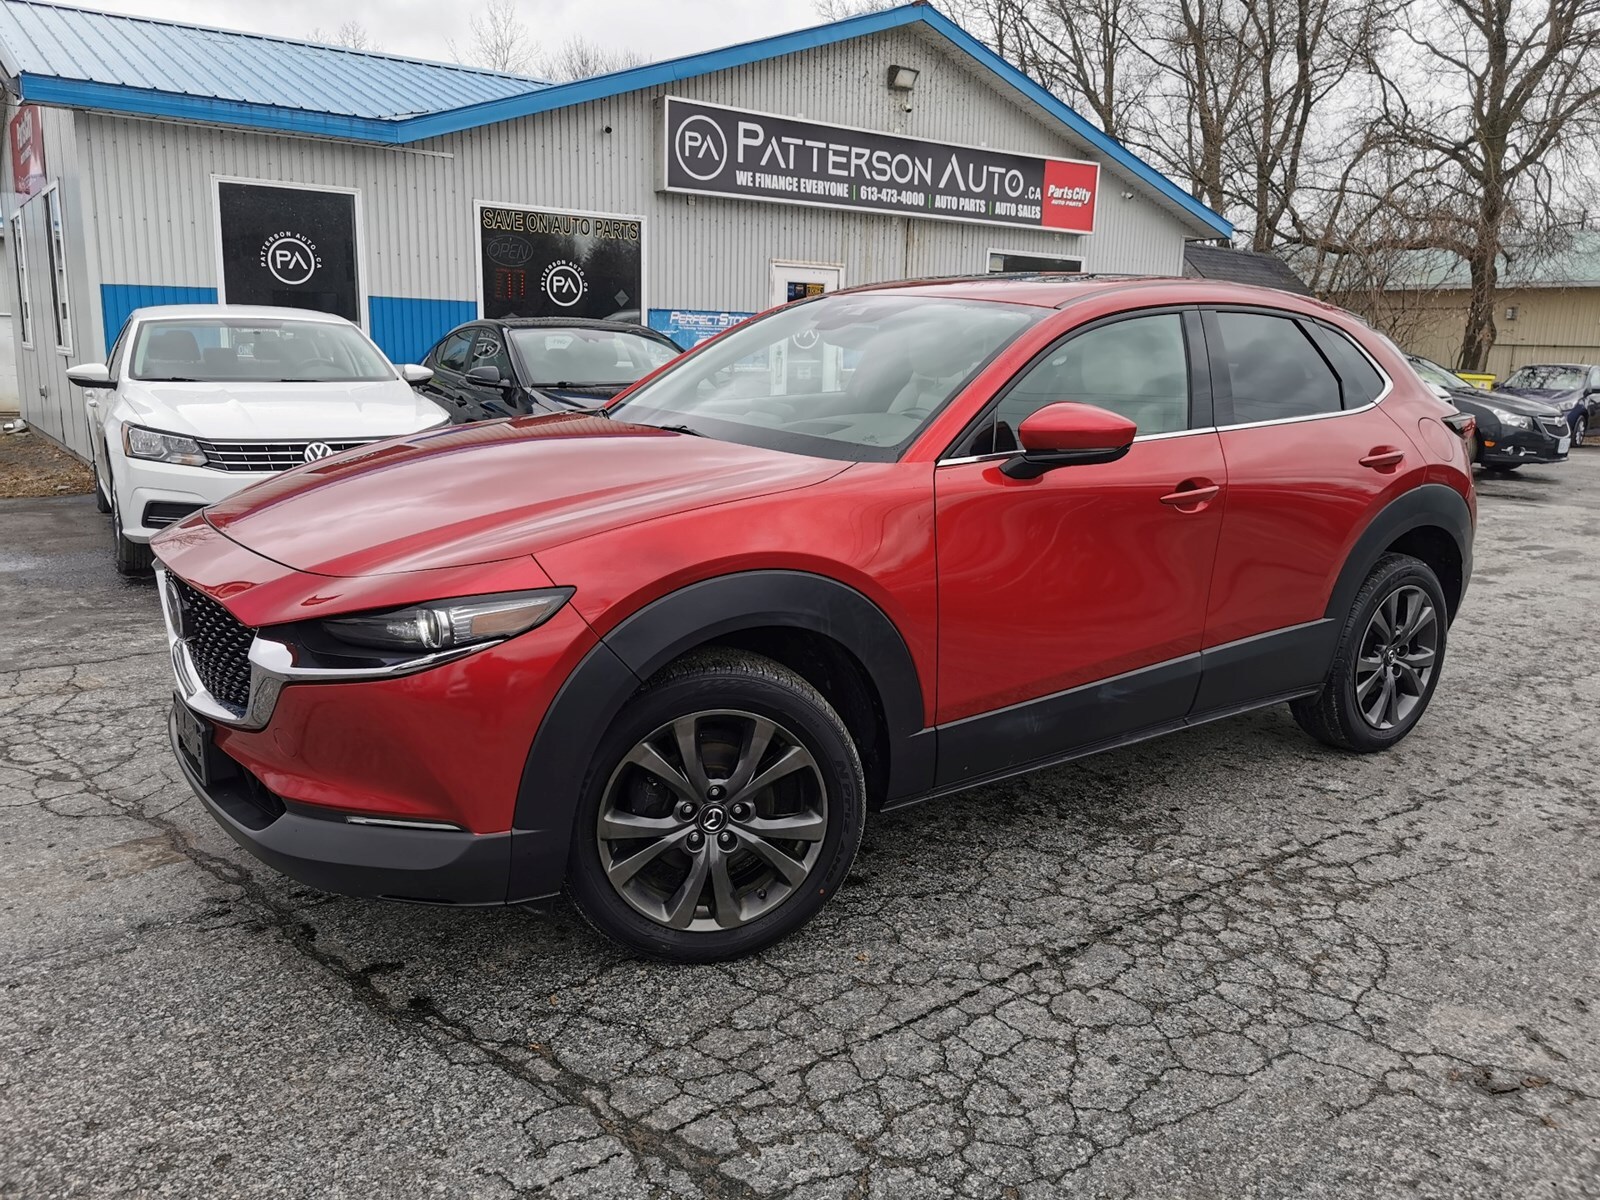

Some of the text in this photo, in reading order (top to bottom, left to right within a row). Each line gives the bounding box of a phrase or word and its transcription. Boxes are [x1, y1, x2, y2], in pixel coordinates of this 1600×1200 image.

[684, 131, 720, 161] PA
[738, 121, 932, 186] PATTERSON
[938, 153, 1024, 198] AUTO
[736, 170, 849, 198] WE FINANCE EVERYONE
[860, 185, 925, 207] 613-473-4000
[935, 194, 986, 213] AUTO PARTS
[995, 201, 1041, 219] AUTO SALES
[482, 209, 639, 240] SAVE ON AUTO PARTS
[260, 231, 291, 268] PATTERSON
[295, 233, 316, 250] AUTO
[275, 250, 309, 270] PA
[489, 241, 529, 260] OPEN
[540, 259, 566, 292] PATTERSON
[552, 275, 578, 293] PA
[669, 311, 748, 327] PERFECTSTO
